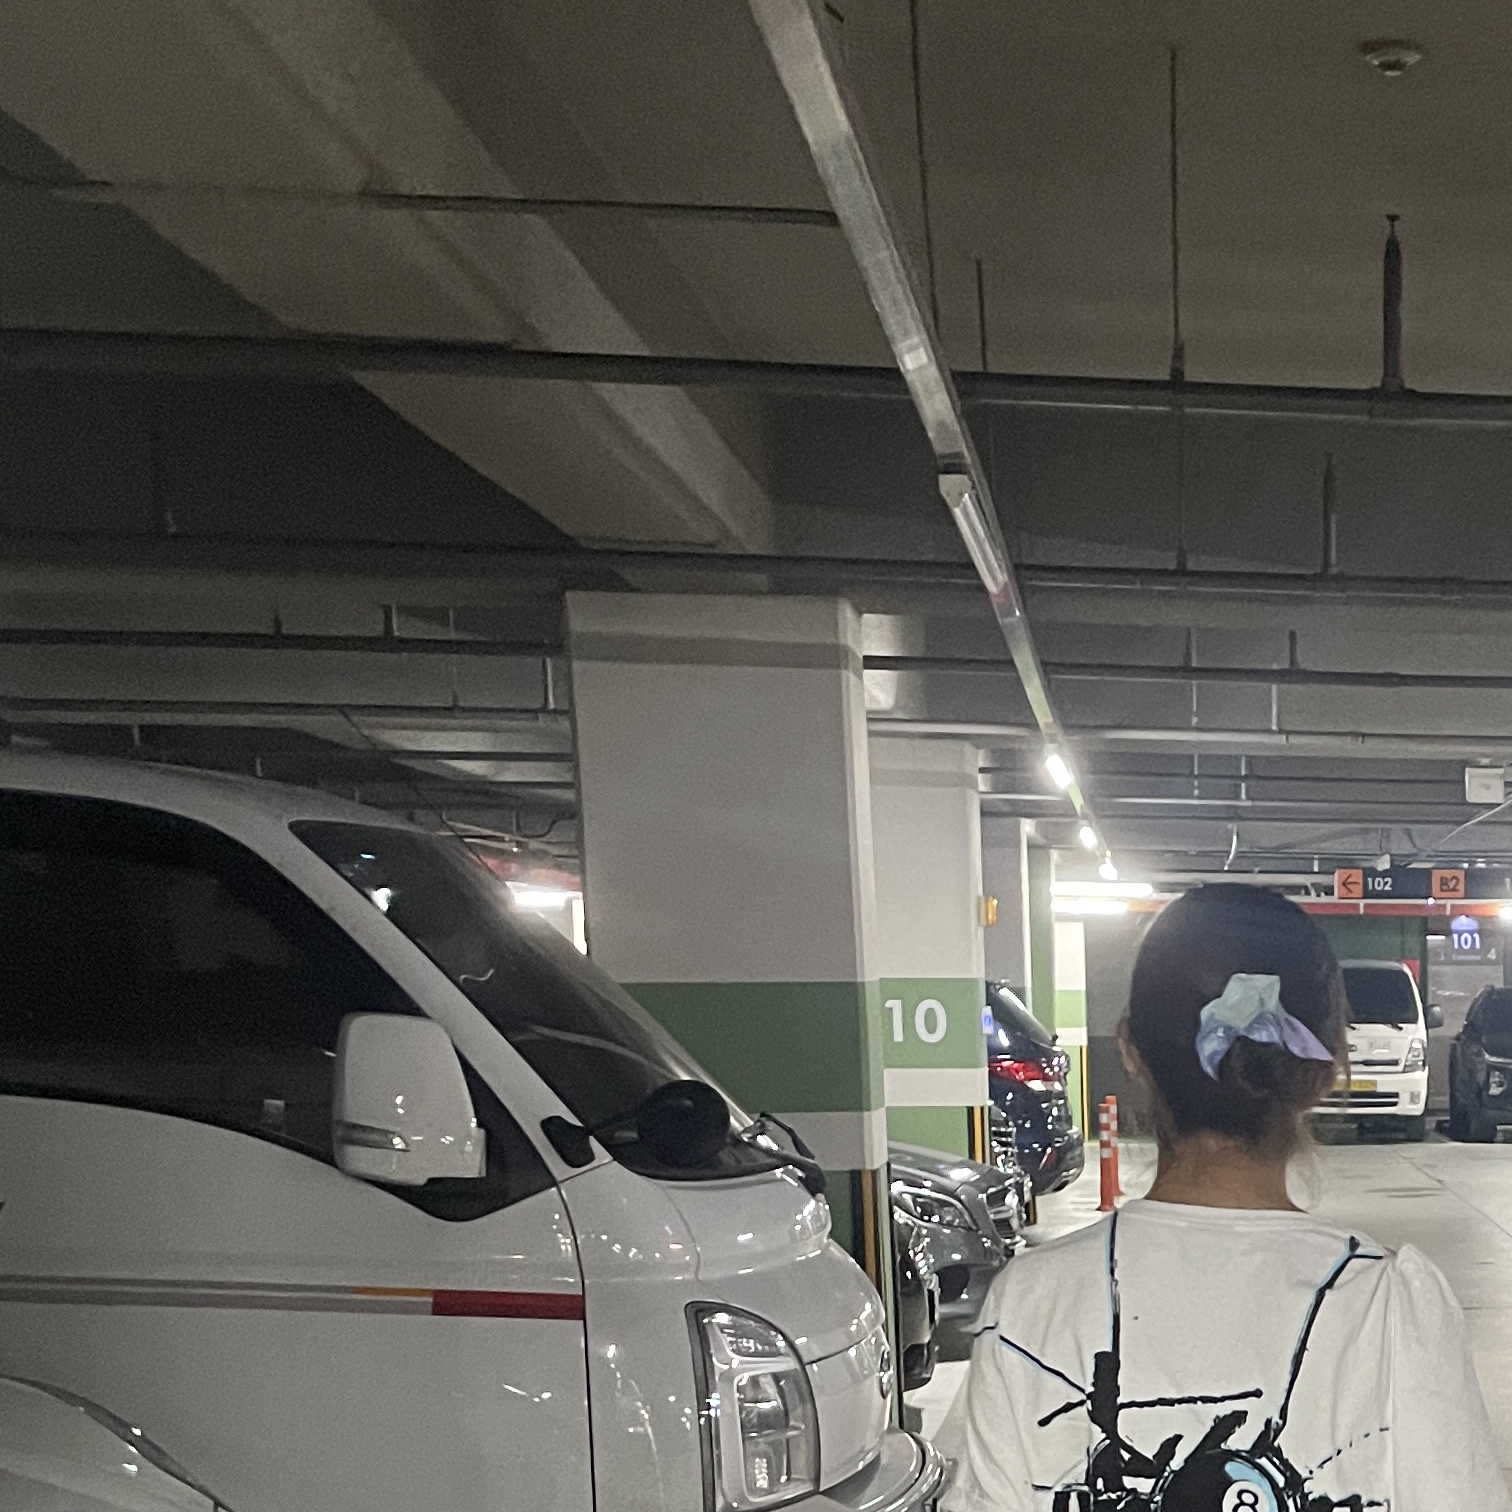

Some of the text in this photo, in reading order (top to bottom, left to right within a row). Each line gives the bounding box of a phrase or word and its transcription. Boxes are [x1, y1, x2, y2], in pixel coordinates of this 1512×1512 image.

[1367, 877, 1393, 891] 102
[1439, 876, 1460, 892] B2
[1452, 932, 1481, 950] 101
[884, 998, 947, 1043] 10
